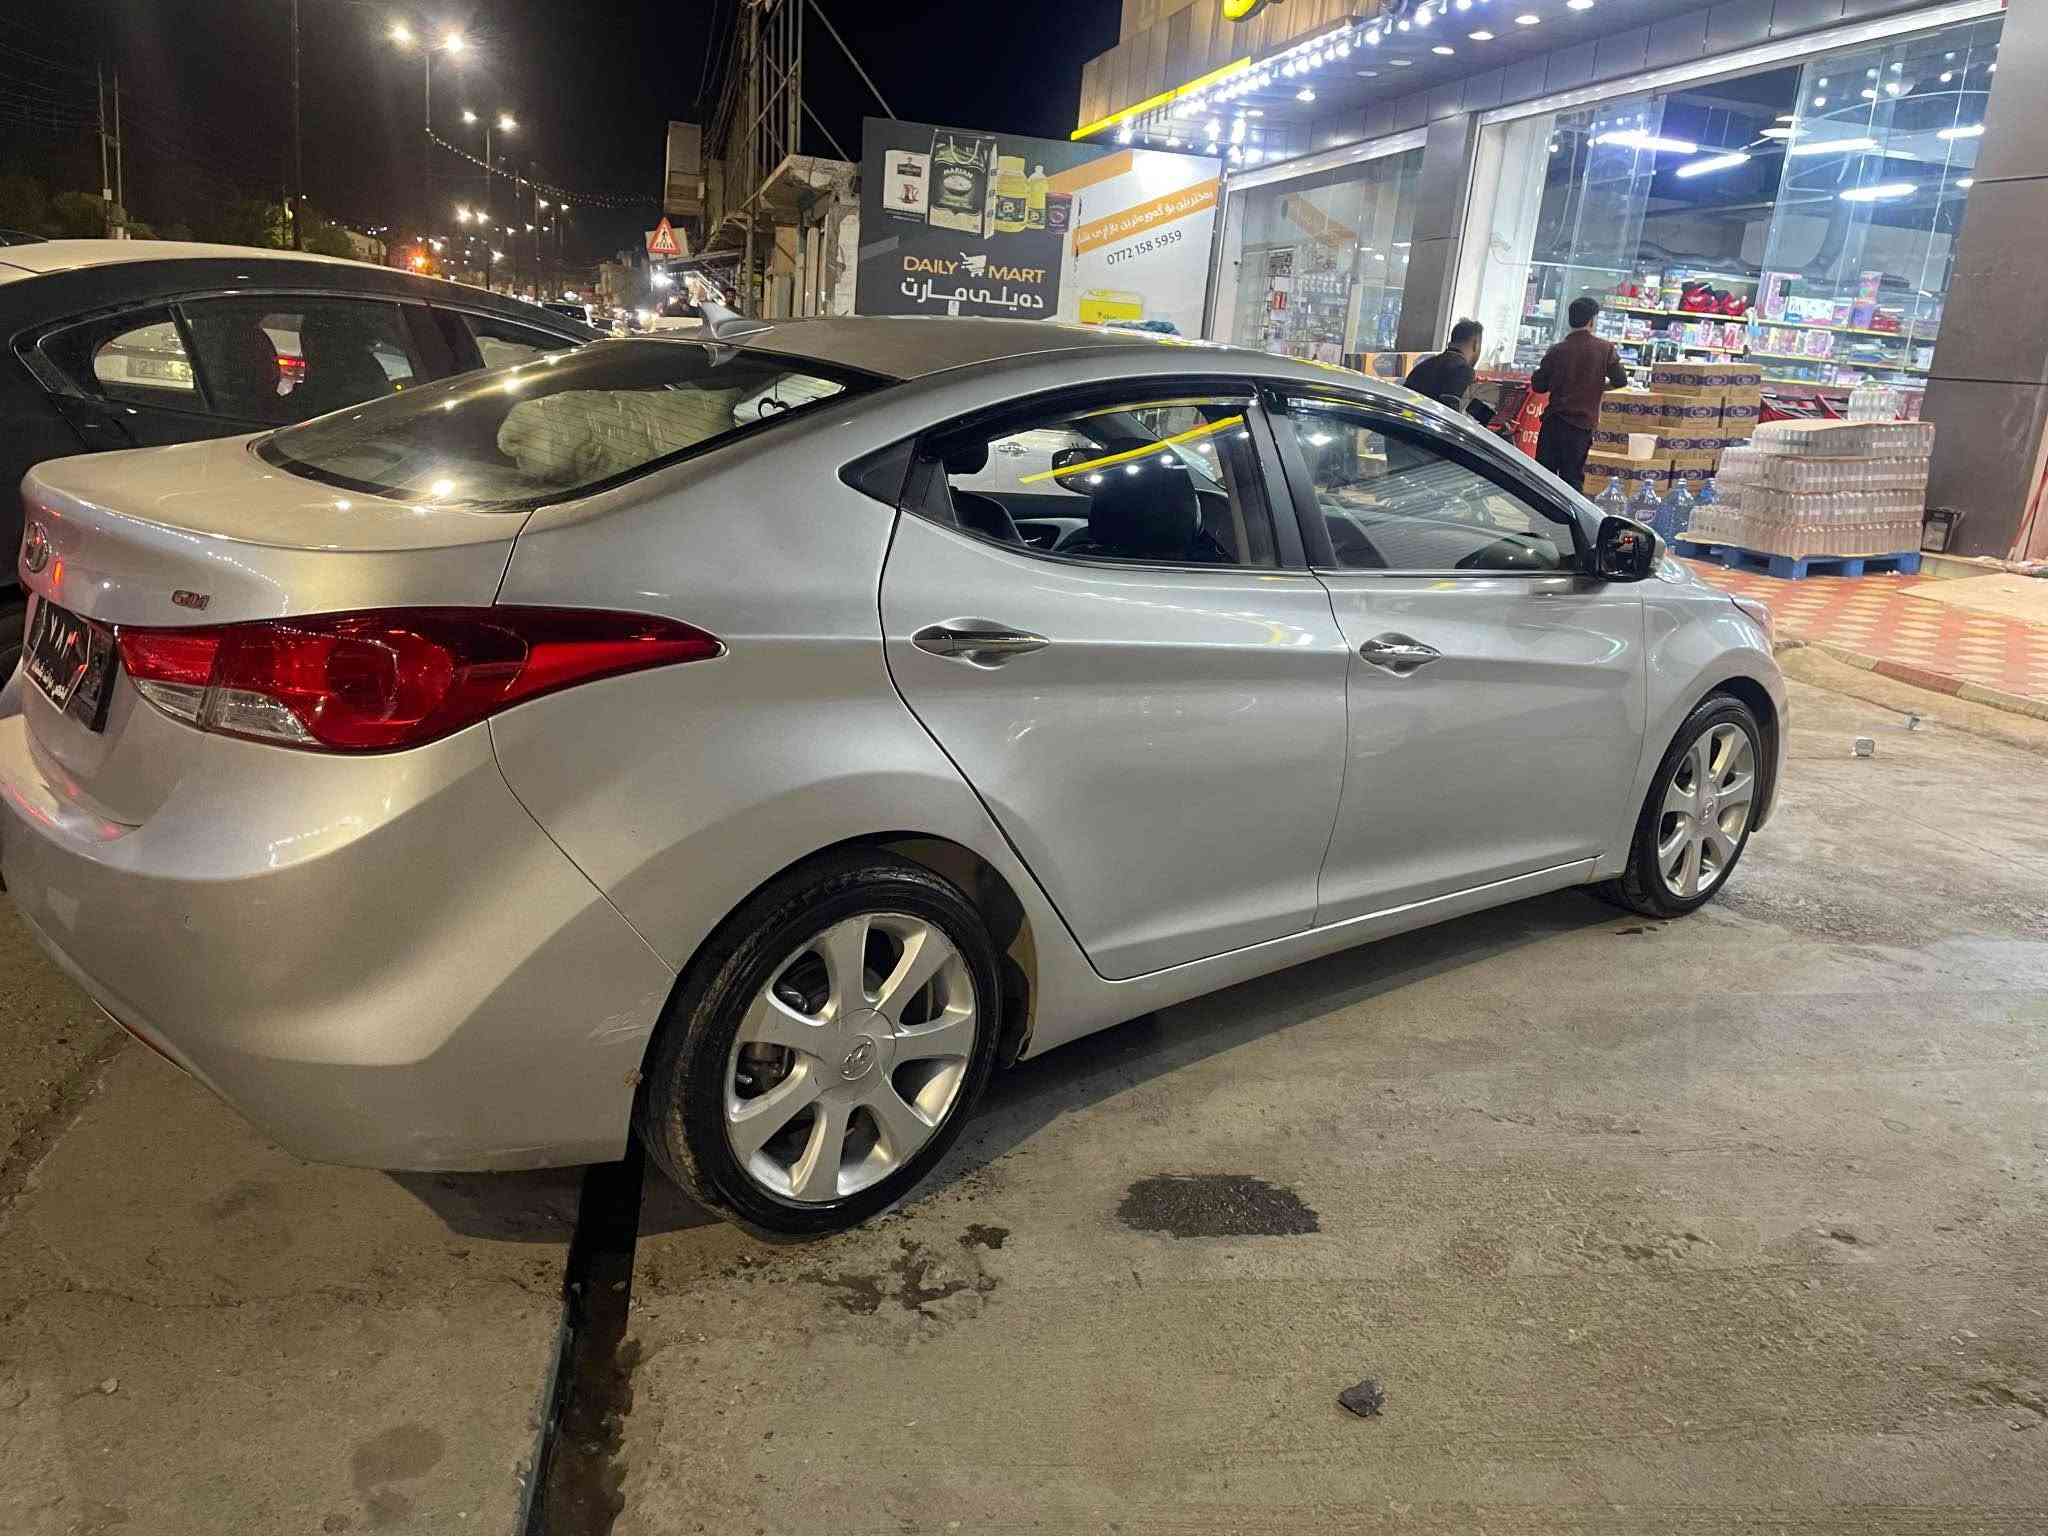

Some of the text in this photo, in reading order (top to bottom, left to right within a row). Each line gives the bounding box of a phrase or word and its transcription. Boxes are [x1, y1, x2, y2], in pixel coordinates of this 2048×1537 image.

[1106, 229, 1183, 266] 0772 158 5959
[903, 255, 1047, 284] DAILY MART
